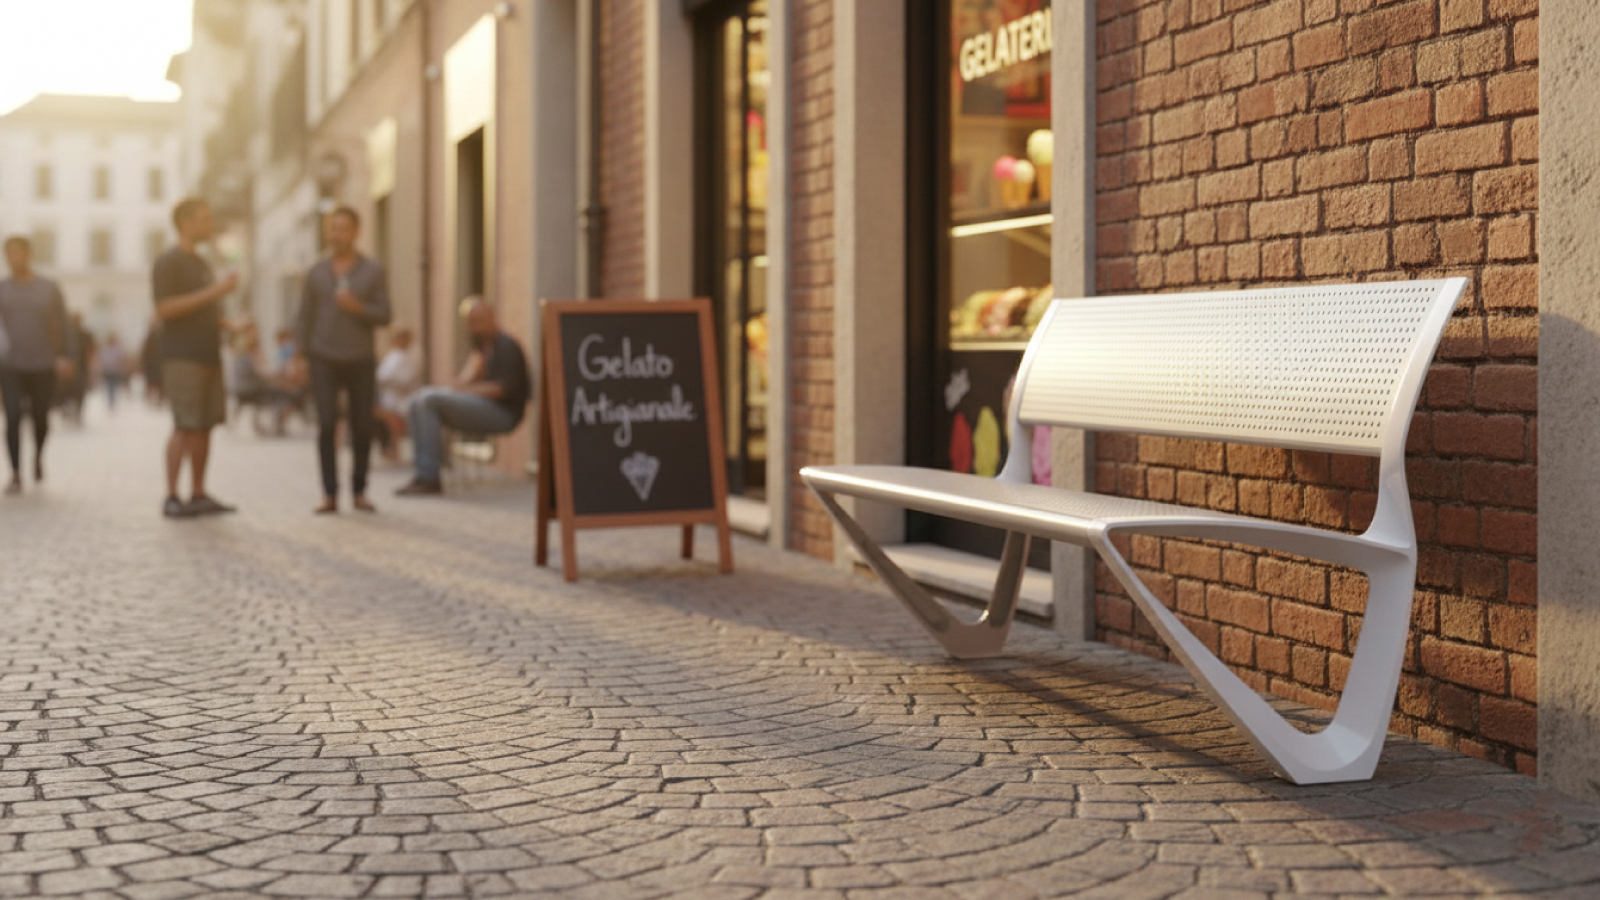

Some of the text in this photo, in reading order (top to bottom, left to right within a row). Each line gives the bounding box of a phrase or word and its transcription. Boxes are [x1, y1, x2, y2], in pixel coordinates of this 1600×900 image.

[959, 7, 1052, 82] GELATERI
[577, 333, 674, 381] Gelato
[571, 383, 697, 447] Artigianale
